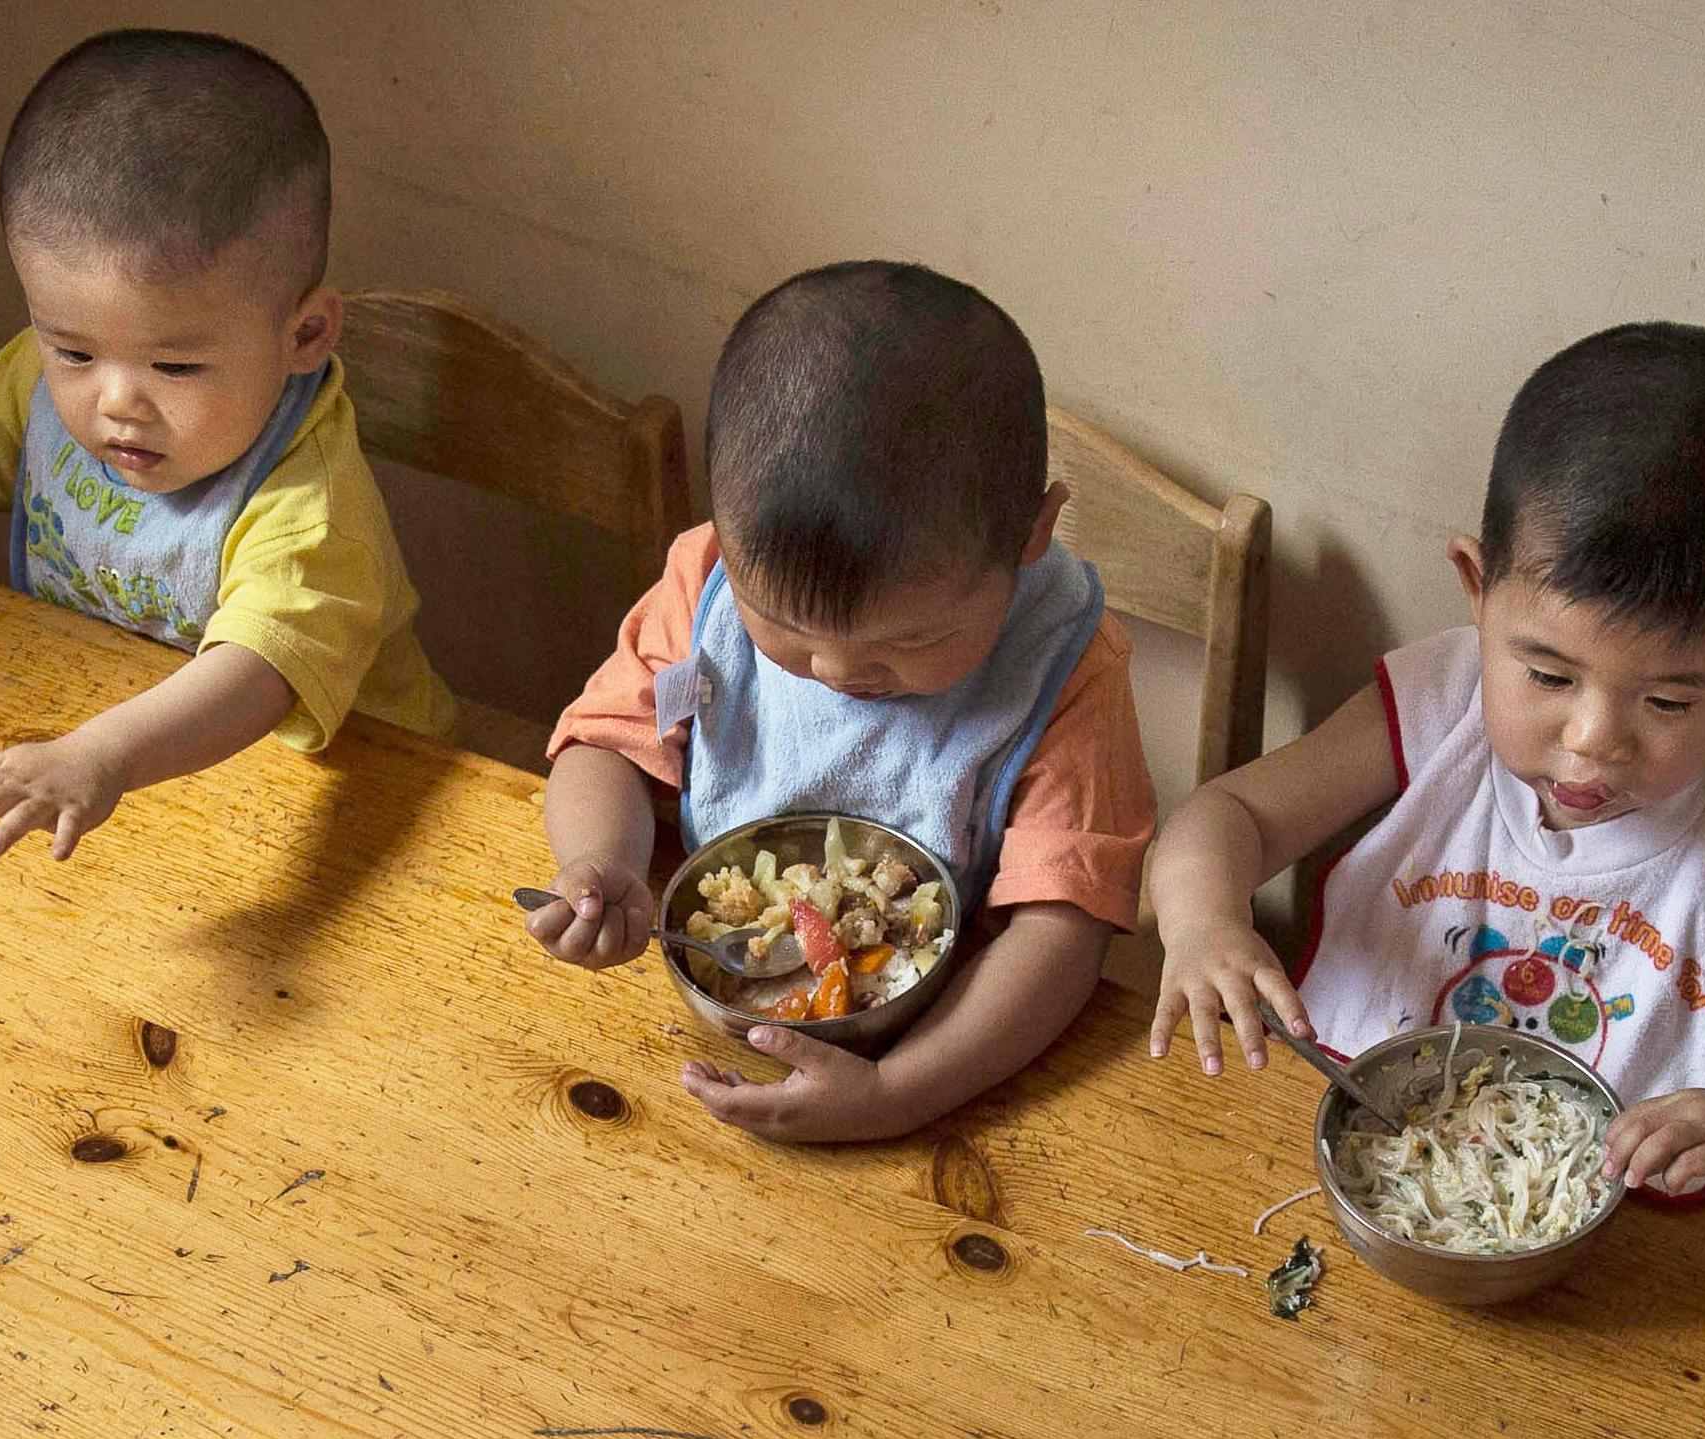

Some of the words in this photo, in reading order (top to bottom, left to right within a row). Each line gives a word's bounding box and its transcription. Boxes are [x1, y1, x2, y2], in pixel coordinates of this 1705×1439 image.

[65, 461, 145, 535] LOVE
[1393, 868, 1540, 911] Immunise
[1607, 901, 1674, 971] time
